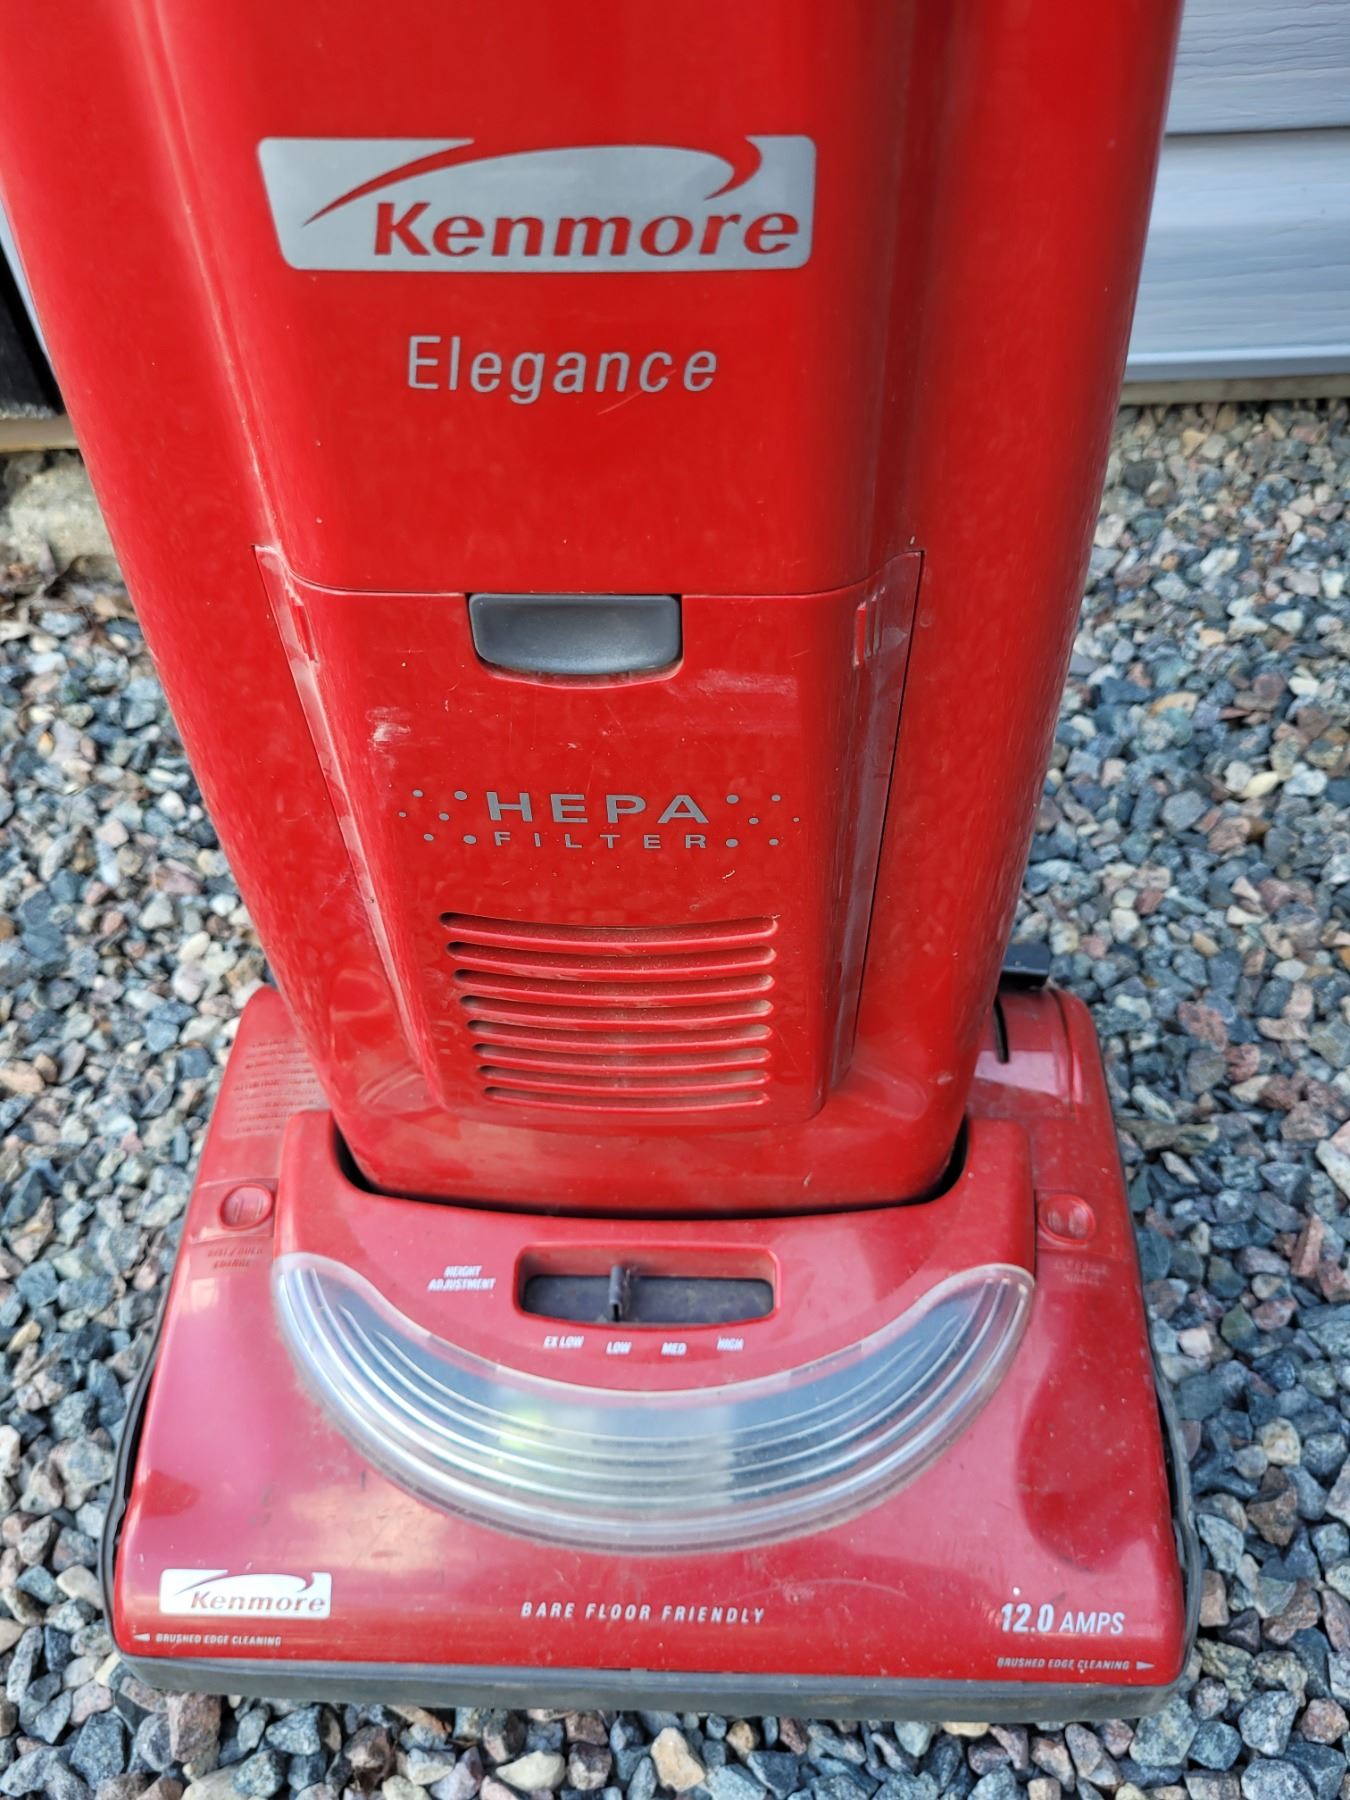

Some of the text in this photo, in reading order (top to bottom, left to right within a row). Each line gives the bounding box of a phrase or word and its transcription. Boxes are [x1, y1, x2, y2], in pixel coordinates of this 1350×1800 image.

[374, 201, 800, 258] Kenmore
[408, 334, 717, 404] Elegance
[485, 791, 709, 824] HEPA
[494, 831, 707, 849] FILTER
[444, 1265, 483, 1278] HEIGHT
[427, 1278, 496, 1291] ADJUSTMENT
[543, 1336, 584, 1349] EX LOW
[606, 1342, 632, 1355] LOW
[661, 1342, 687, 1355] MED
[717, 1337, 744, 1350] HIGH
[190, 1590, 326, 1613] Kenmore
[520, 1601, 765, 1624] BARE FLOOR FRIENDLY
[1001, 1603, 1126, 1635] 12.0 AMPS
[155, 1632, 282, 1647] BRUSHED EDGE CLEANING
[997, 1656, 1131, 1671] BRUSHED EDGE CLEANING
